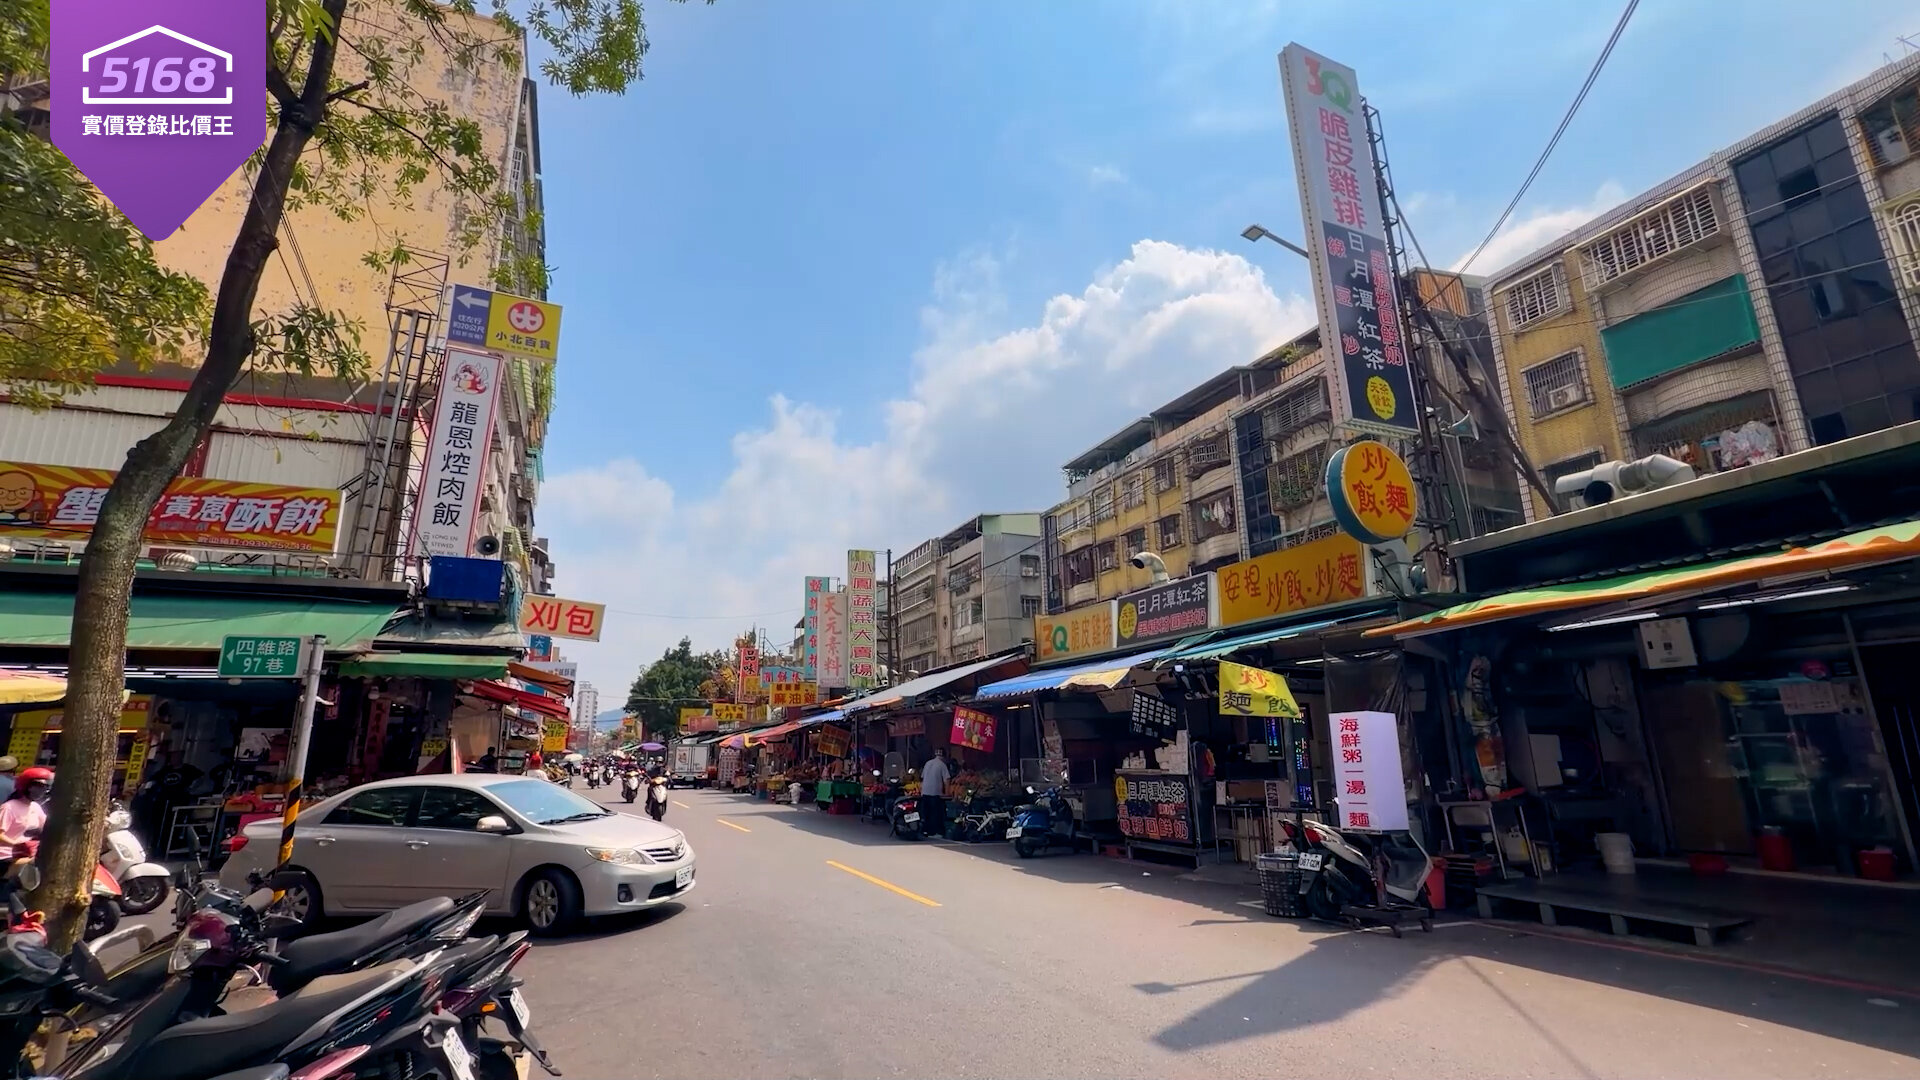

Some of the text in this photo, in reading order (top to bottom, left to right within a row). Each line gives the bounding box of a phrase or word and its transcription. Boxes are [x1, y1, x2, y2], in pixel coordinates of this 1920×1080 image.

[1304, 56, 1353, 115] 3Q
[1319, 107, 1367, 230] 脆皮雞排
[1348, 231, 1385, 371] 日月潭紅茶
[496, 331, 551, 350] 小北百貨
[432, 400, 479, 527] 龍恩焢肉飯
[1362, 447, 1390, 480] 炒
[1138, 581, 1206, 615] 日月潭紅茶
[526, 601, 594, 636] 刈包
[824, 595, 842, 676] 天元素料
[236, 640, 297, 656] 四維路
[1043, 624, 1069, 656] 3Q
[743, 650, 756, 675] 品味
[1340, 718, 1362, 764] 海鮮粥
[1128, 781, 1186, 803] 日月潭紅茶
